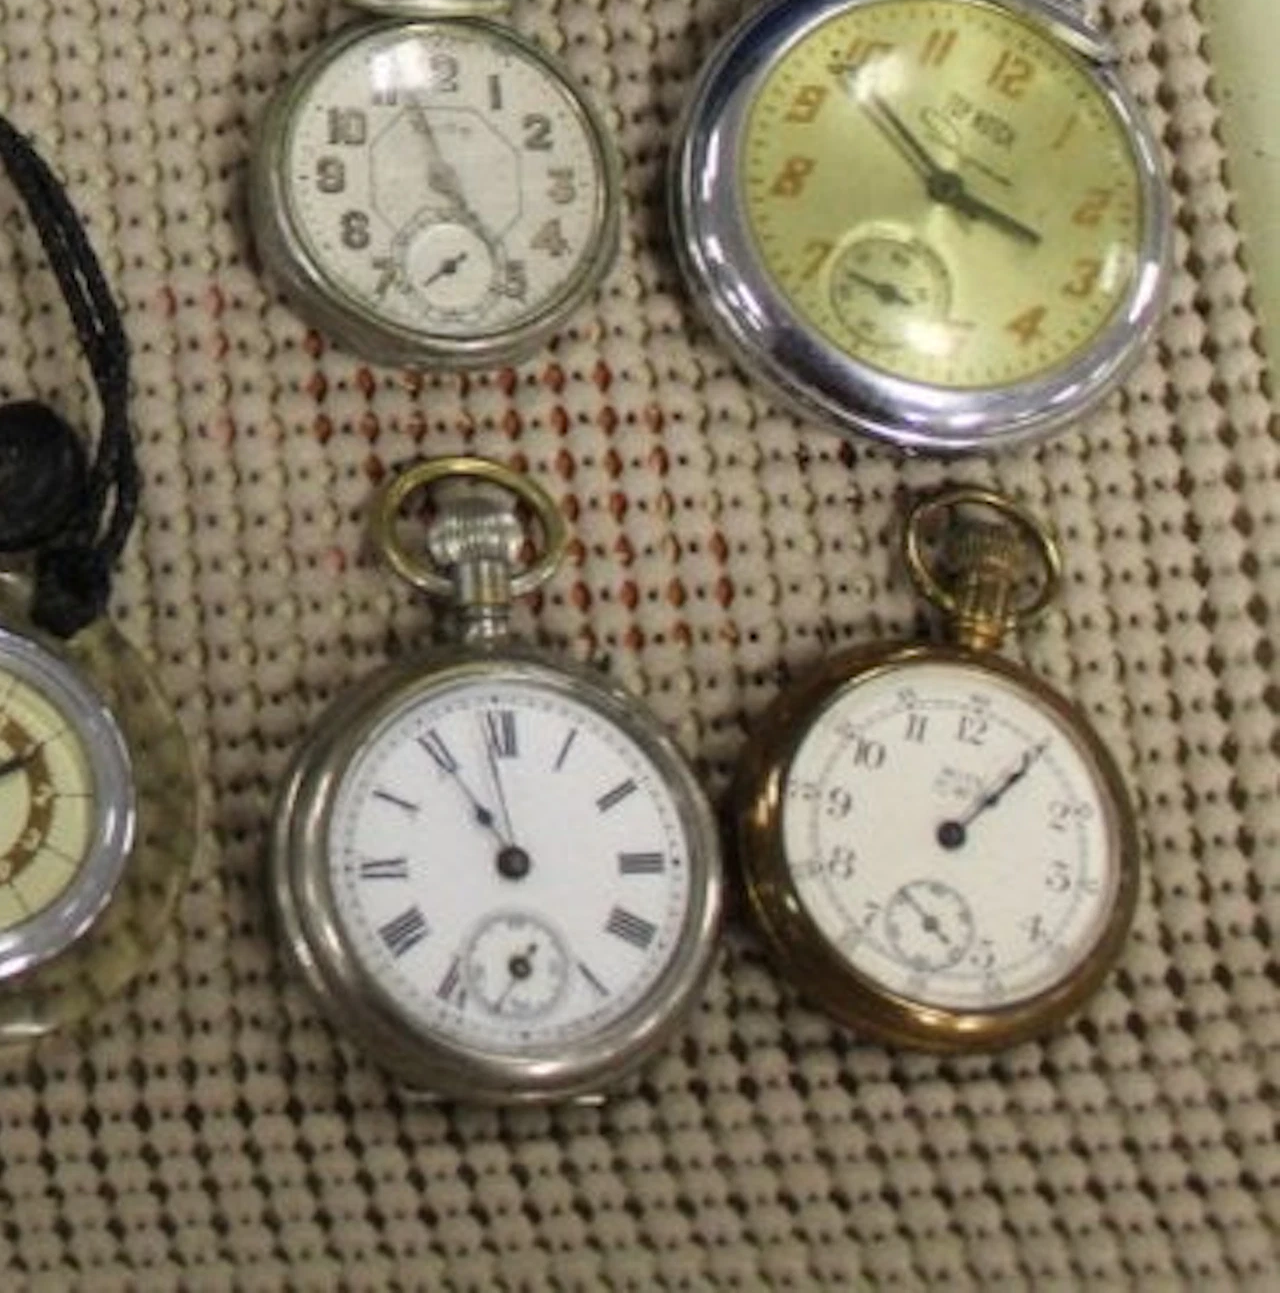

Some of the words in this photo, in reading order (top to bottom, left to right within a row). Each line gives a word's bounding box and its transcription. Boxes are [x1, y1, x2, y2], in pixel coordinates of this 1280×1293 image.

[987, 49, 1037, 97] 12
[522, 113, 553, 152] 2
[957, 716, 989, 747] 12
[853, 736, 887, 771] 10
